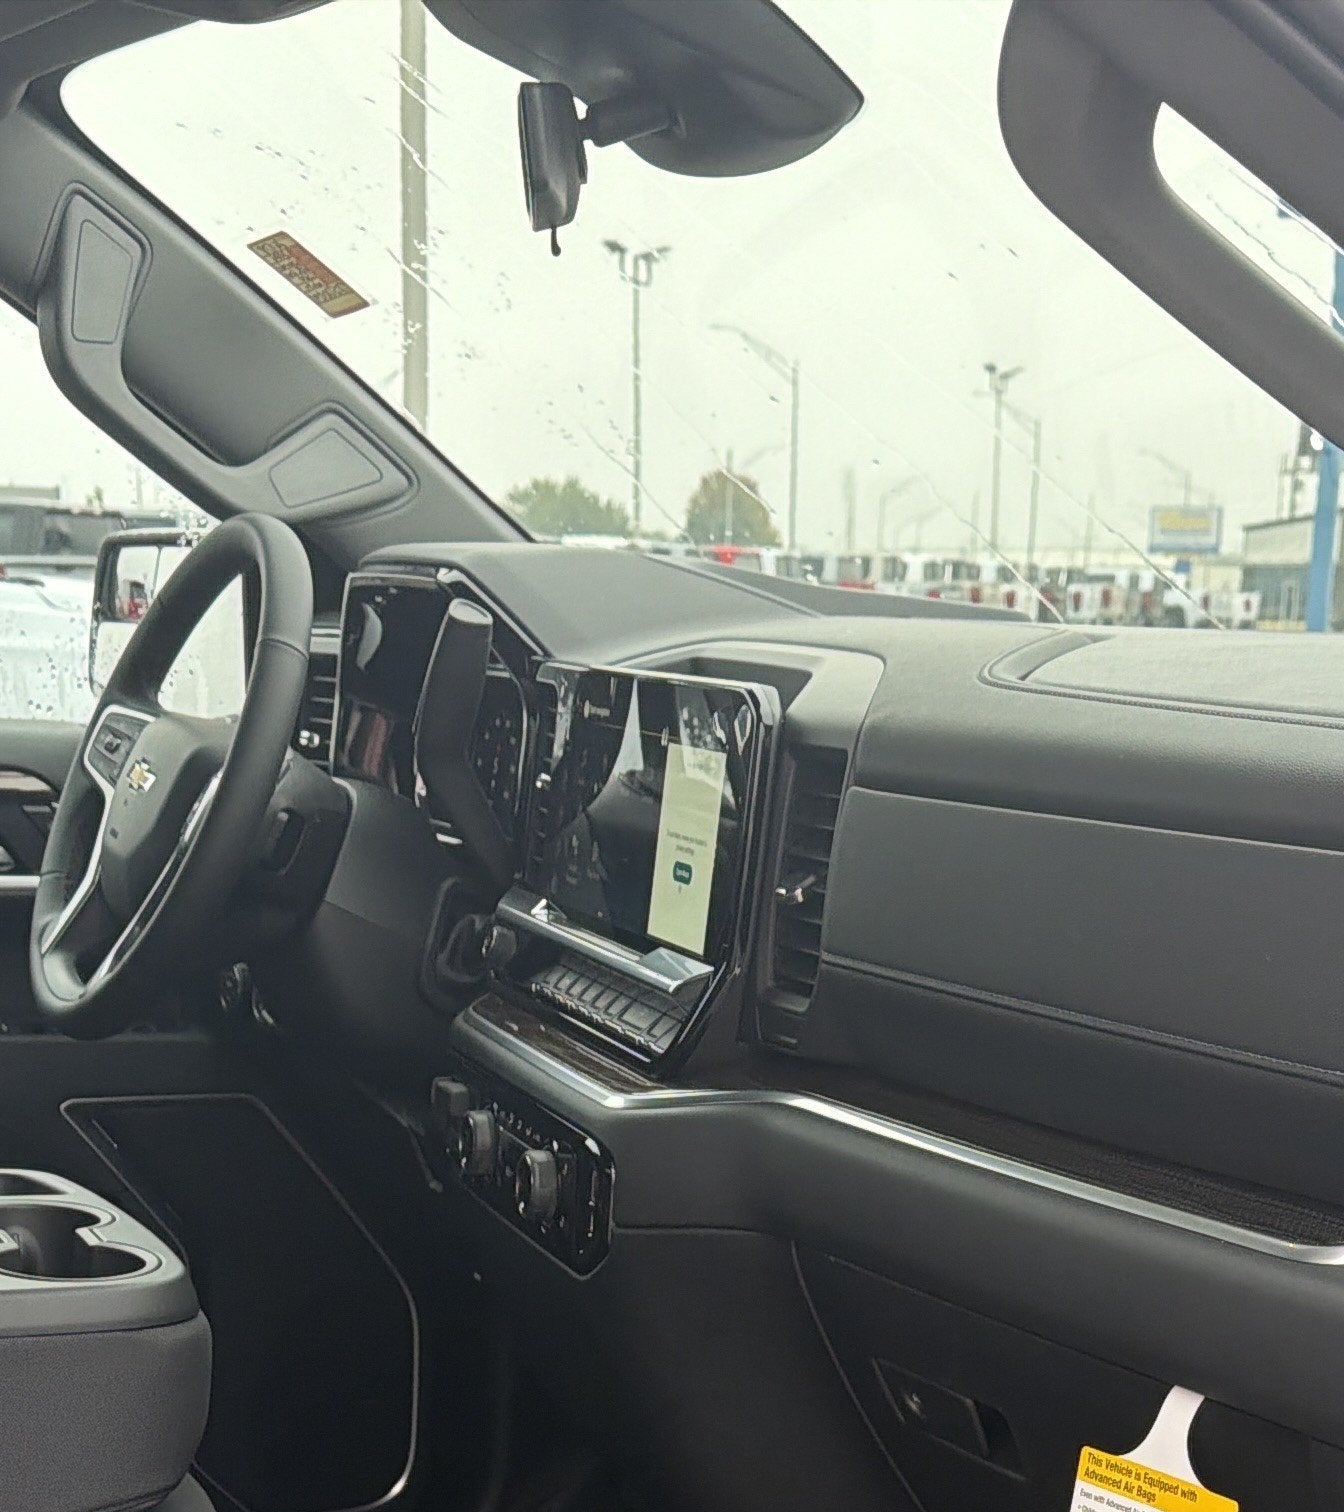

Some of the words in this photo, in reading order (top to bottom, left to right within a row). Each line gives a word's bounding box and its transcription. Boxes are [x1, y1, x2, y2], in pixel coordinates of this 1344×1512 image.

[1084, 1466, 1122, 1489] Advanced
[1123, 1480, 1135, 1493] Air
[1136, 1485, 1157, 1503] Bags
[1087, 1451, 1103, 1468] This
[1105, 1458, 1133, 1477] Vehicle
[1134, 1468, 1141, 1481] is
[1143, 1472, 1179, 1495] Equipped
[1180, 1485, 1198, 1502] with
[1080, 1488, 1093, 1499] Even
[1093, 1494, 1105, 1504] with
